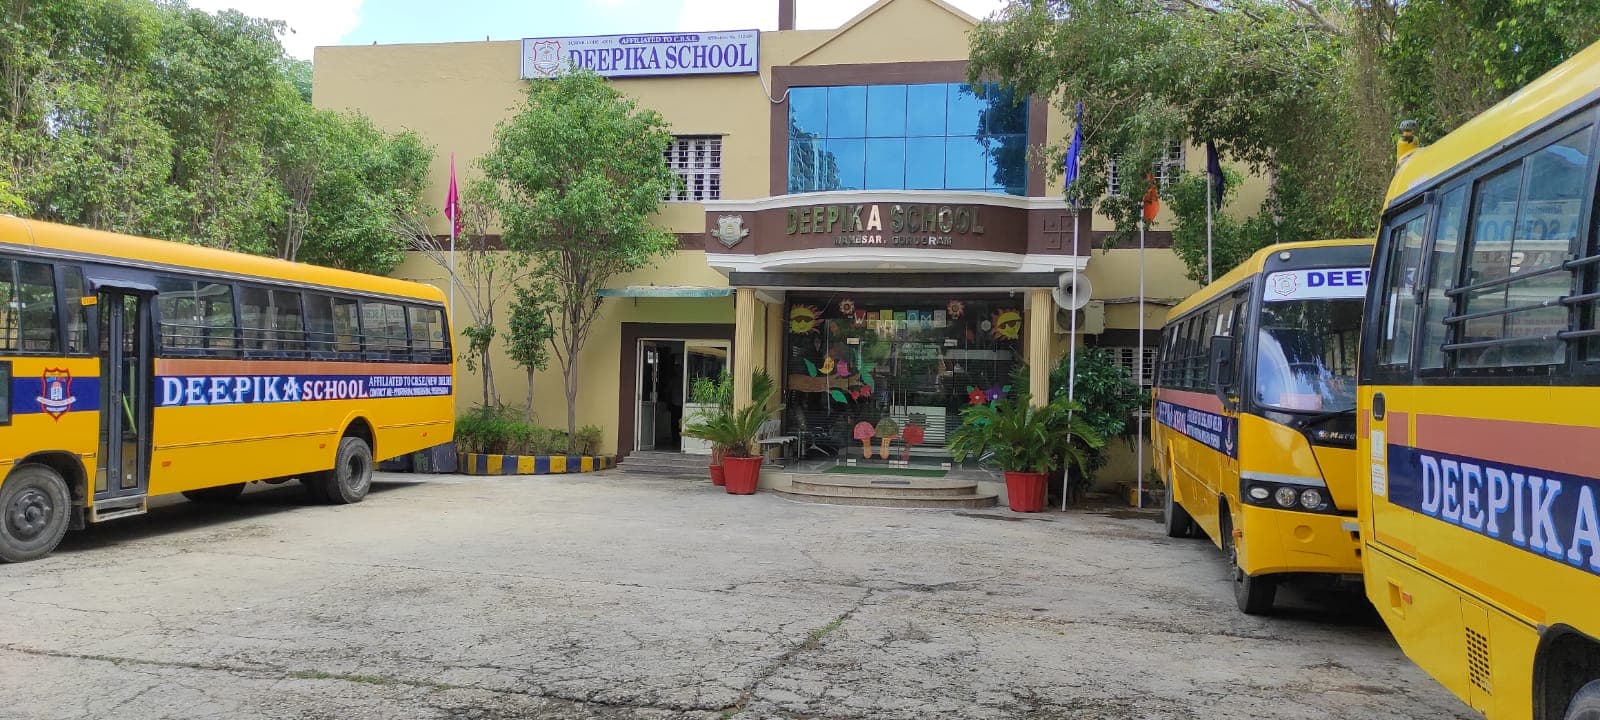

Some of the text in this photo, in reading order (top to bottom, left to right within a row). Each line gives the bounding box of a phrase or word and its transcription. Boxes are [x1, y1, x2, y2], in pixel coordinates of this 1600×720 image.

[568, 43, 753, 72] DEEPIKA SCHOOL
[785, 204, 985, 235] DEEPIKA SCHOOL
[161, 376, 300, 406] DEEPIKA
[302, 380, 369, 400] SCHOOL
[369, 376, 402, 387] AFFILIATED
[1420, 454, 1600, 572] DEEPIKA
